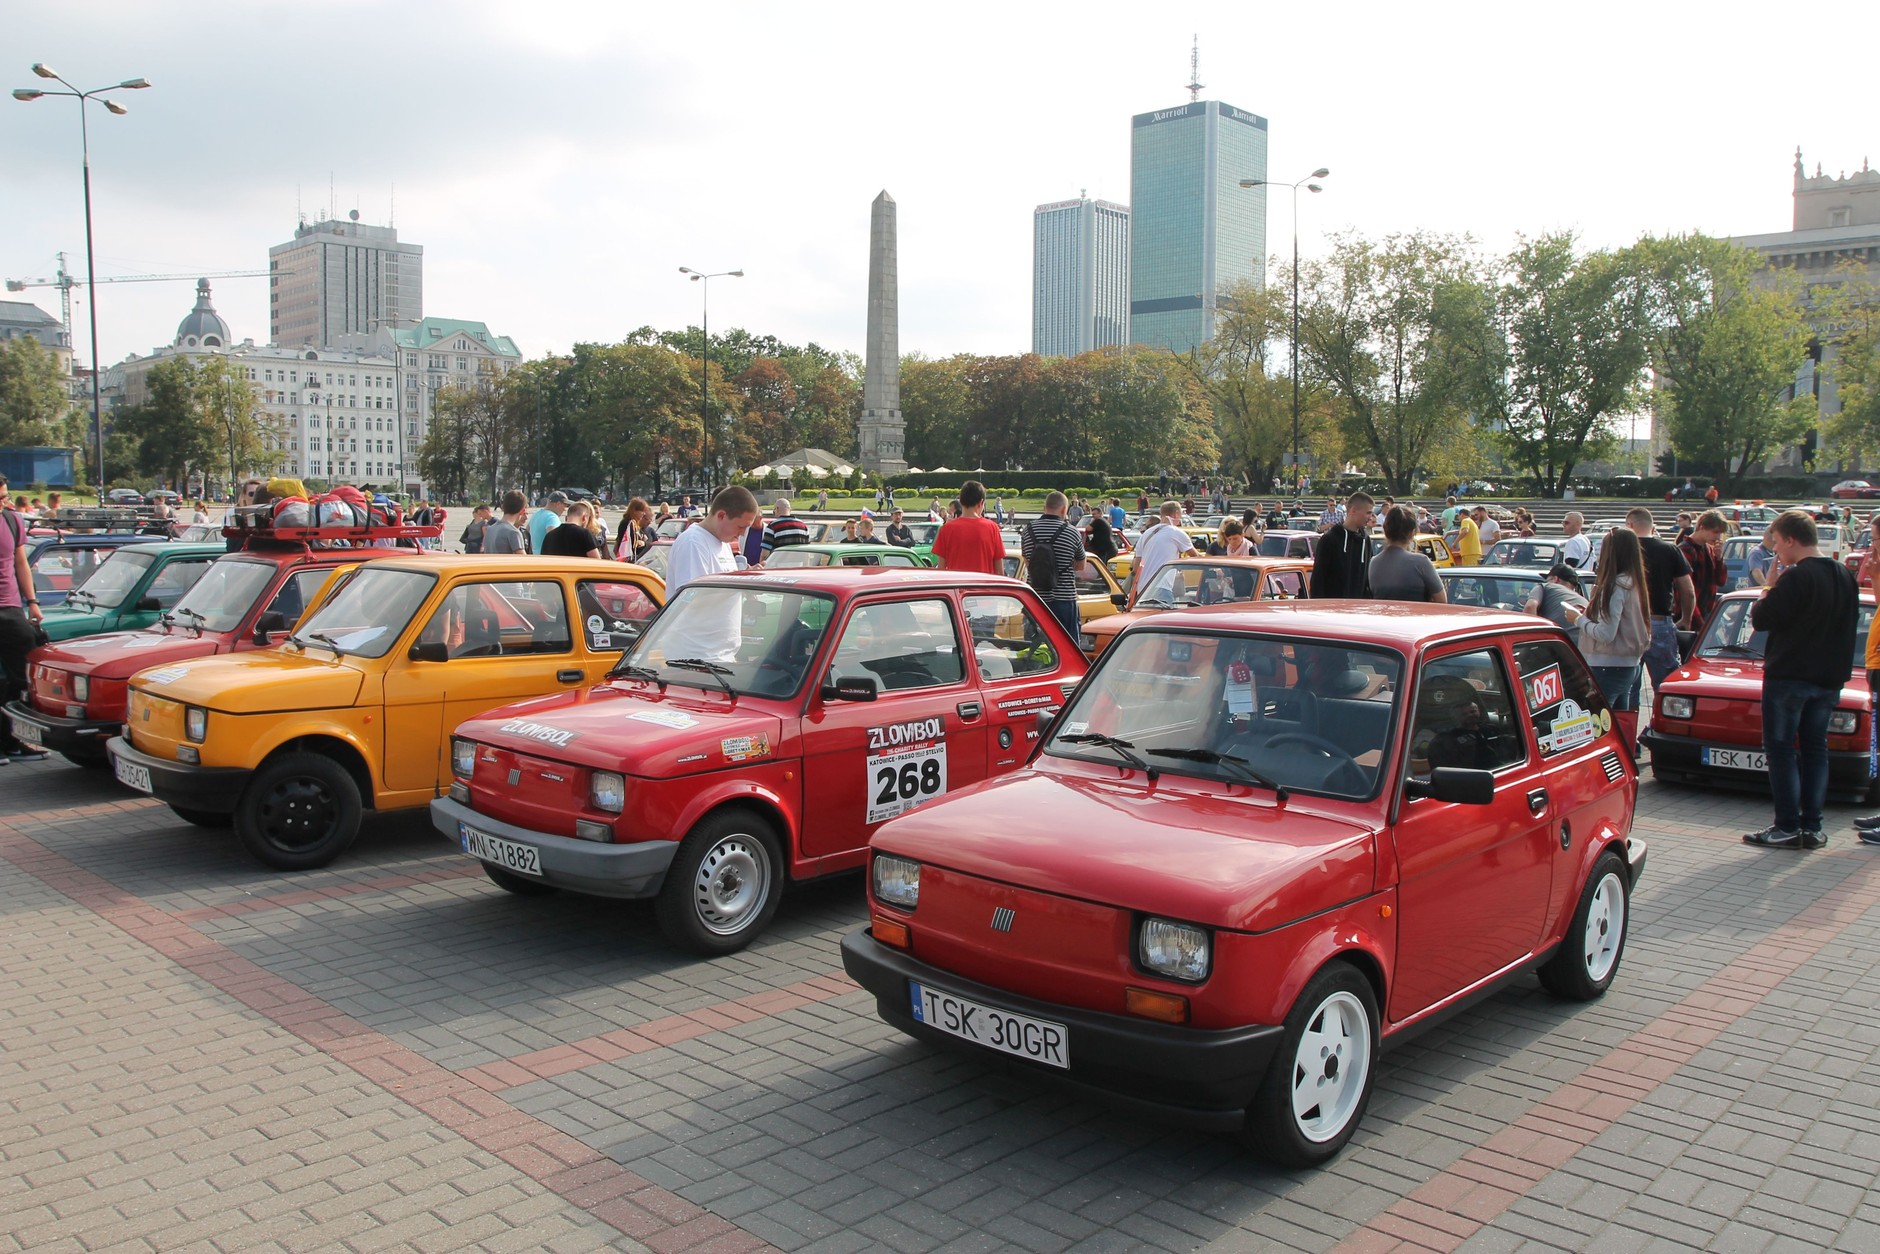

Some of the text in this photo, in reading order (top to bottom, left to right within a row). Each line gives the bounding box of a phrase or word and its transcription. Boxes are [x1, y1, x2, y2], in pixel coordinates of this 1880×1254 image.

[1151, 107, 1188, 123] Marriott
[1231, 108, 1257, 124] Marriott
[1533, 671, 1557, 705] 067
[1565, 704, 1573, 719] 67
[867, 718, 946, 749] ZLOMBOL
[869, 756, 895, 766] KATOWICE
[898, 752, 915, 760] PASSO
[926, 747, 945, 756] STELVIO
[894, 745, 914, 754] CHARITY
[1711, 750, 1739, 767] TSK
[876, 758, 941, 805] 268
[466, 829, 538, 873] WN 51882
[913, 1004, 923, 1016] PL
[925, 990, 1062, 1064] TSK 30GR
